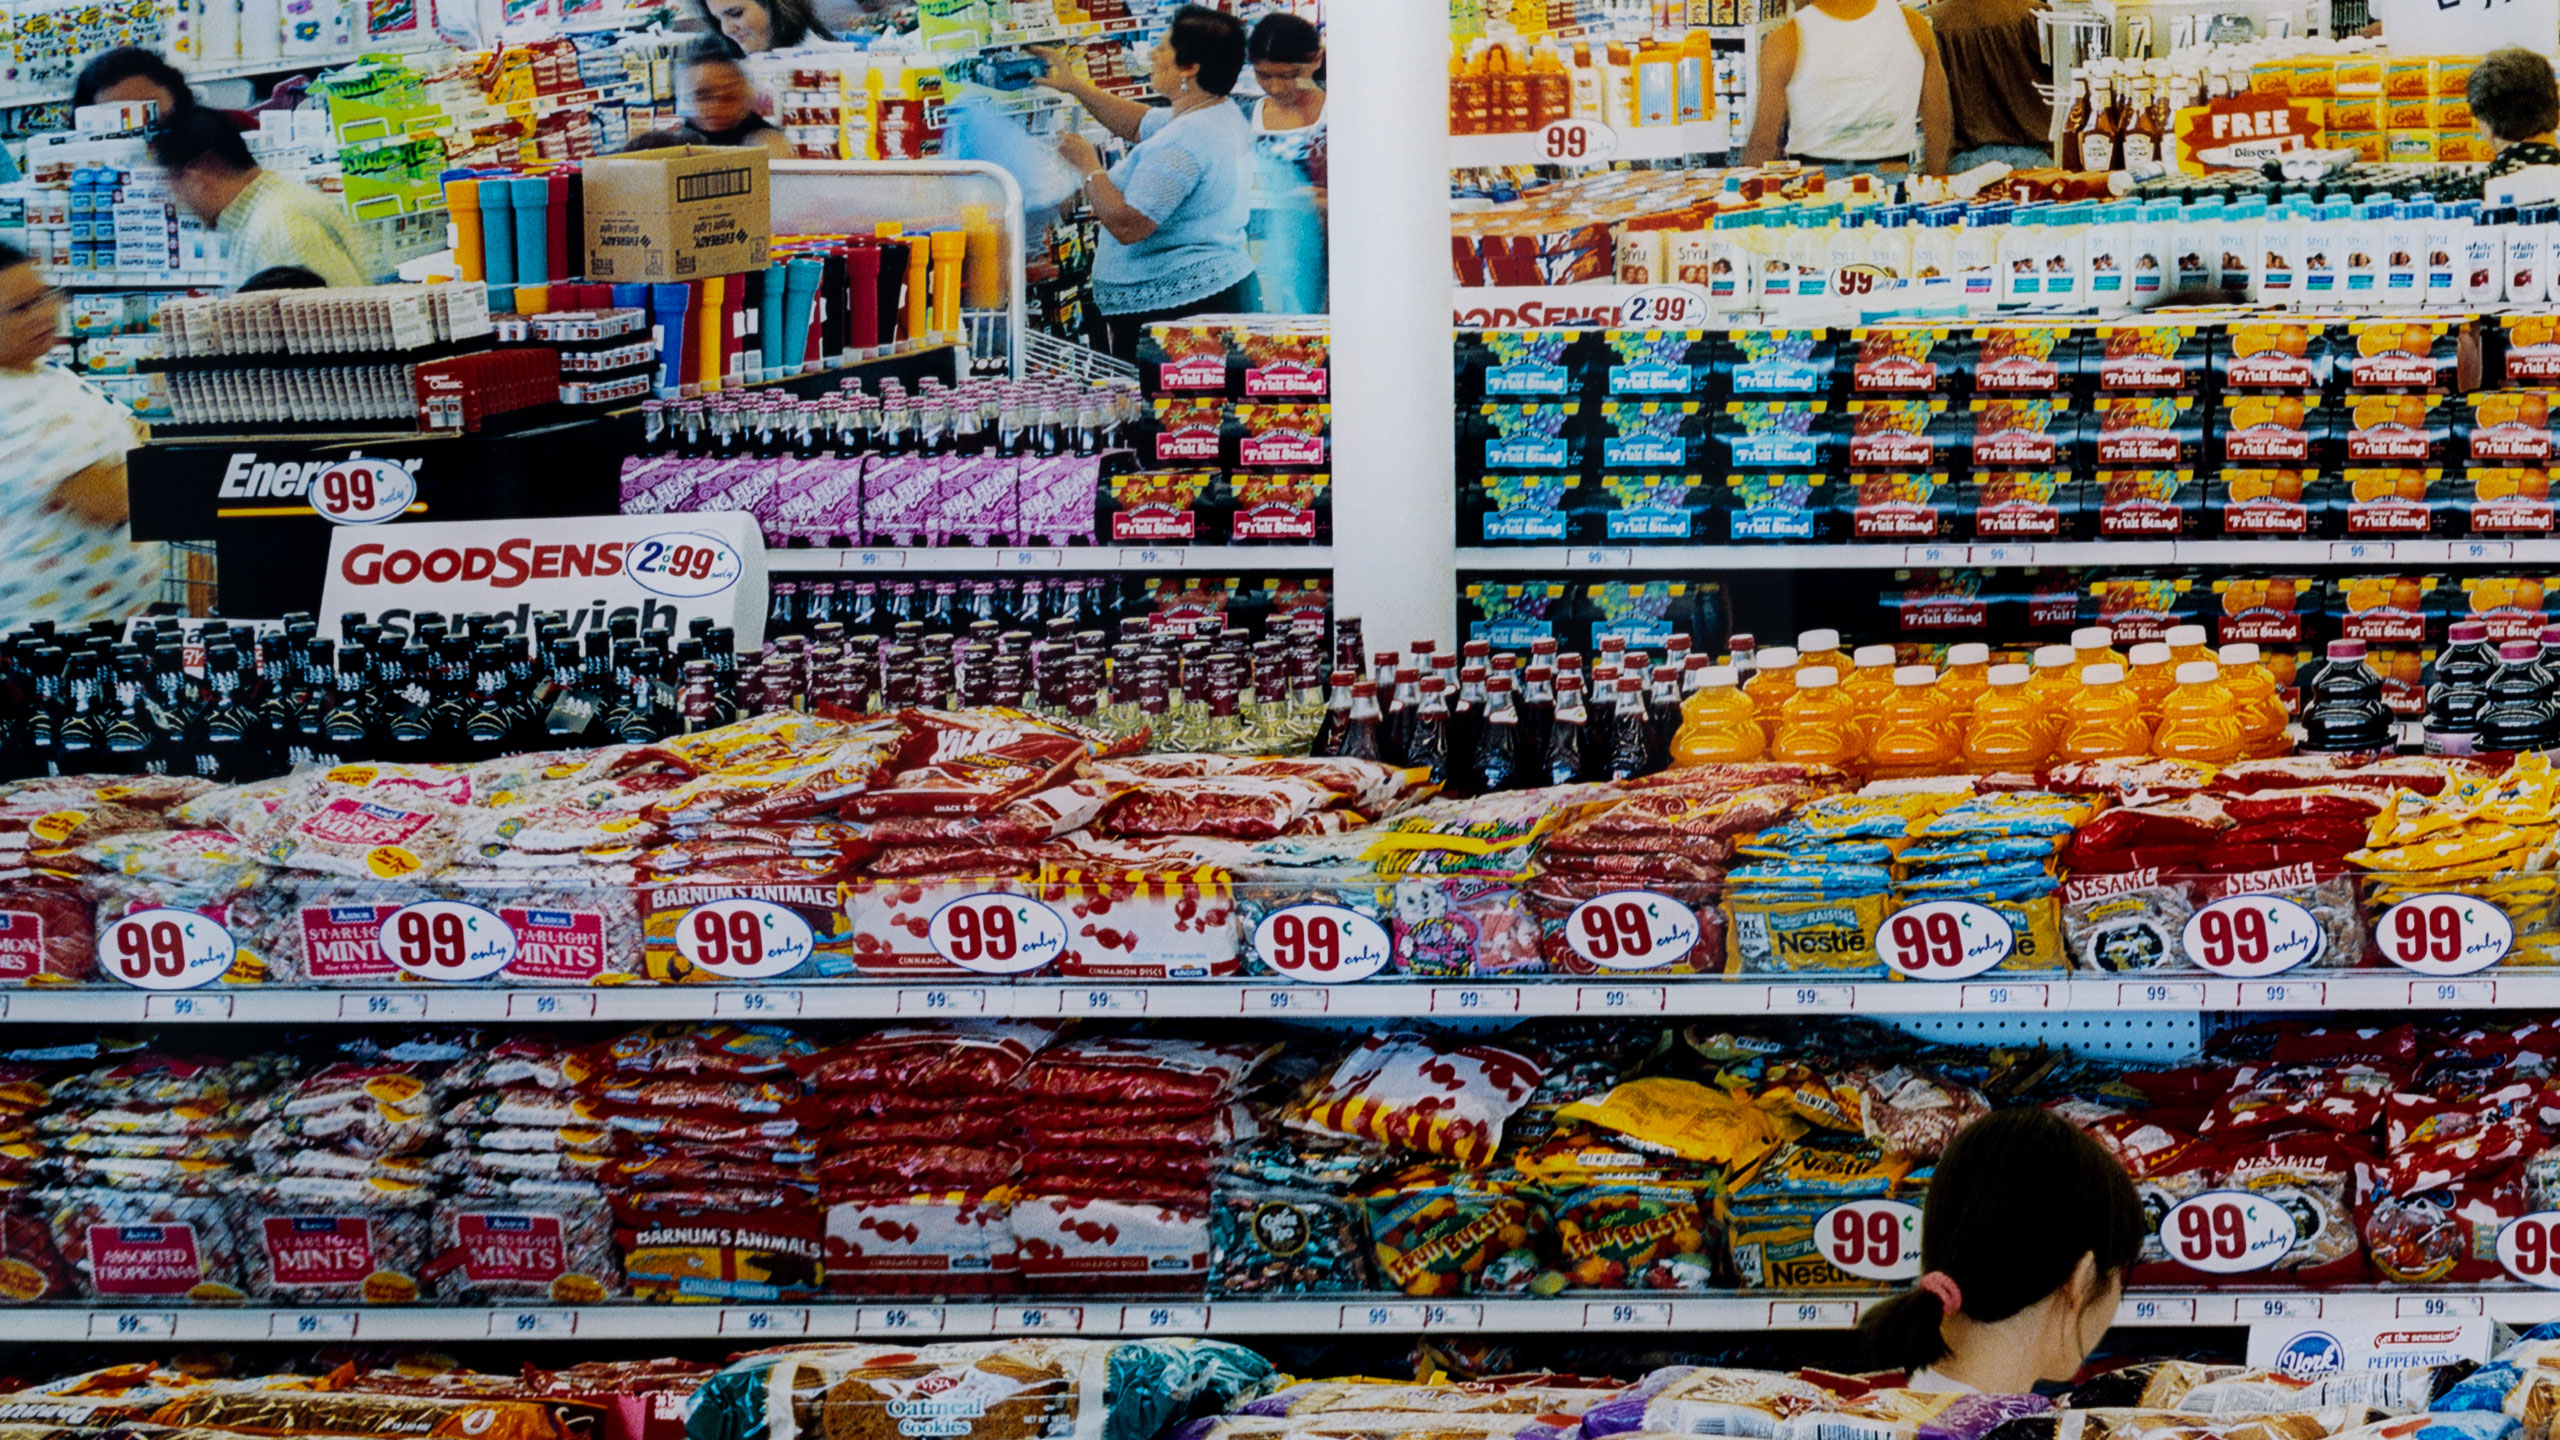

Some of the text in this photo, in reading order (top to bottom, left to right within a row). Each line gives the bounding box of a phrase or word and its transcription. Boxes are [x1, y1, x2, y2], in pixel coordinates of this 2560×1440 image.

[2212, 110, 2290, 138] FREE
[1629, 298, 1648, 322] 2
[324, 469, 384, 513] 99¢
[779, 467, 859, 519] BIG HEAD
[864, 466, 940, 518] BIG HEAD
[940, 466, 1018, 518] BIG HEAD
[1020, 466, 1097, 519] BIG HEAD
[342, 539, 634, 588] GOODSENS
[636, 541, 664, 573] 2
[668, 545, 725, 579] 99¢
[652, 885, 838, 909] BARNUM'S ANIMALS
[2070, 868, 2157, 901] SESAME
[2229, 862, 2315, 896] SESAME
[117, 921, 226, 979] 99¢ only
[314, 940, 382, 963] MINT
[398, 911, 506, 968] 99¢ only
[694, 910, 803, 966] 99¢ only
[948, 906, 1058, 962] 99¢ only
[1273, 915, 1381, 972] 99¢ only
[1582, 902, 1691, 959] 99¢ only
[1892, 912, 1972, 971] 99¢
[1968, 934, 2004, 957] only
[2200, 907, 2309, 967] 99¢ only
[2394, 906, 2502, 963] 99¢ only
[1089, 967, 1163, 977] CINNAMON DISCS
[637, 1230, 822, 1259] BARNUM'S ANIMALS
[1833, 1208, 1914, 1267] 99¢
[2178, 1204, 2288, 1261] 99¢ only
[279, 1249, 365, 1271] MINTS
[470, 1249, 556, 1270] MINTS
[2284, 1346, 2337, 1373] York
[2395, 1332, 2410, 1343] the
[887, 1399, 985, 1418] Oatmeal
[899, 1418, 972, 1436] Cookies
